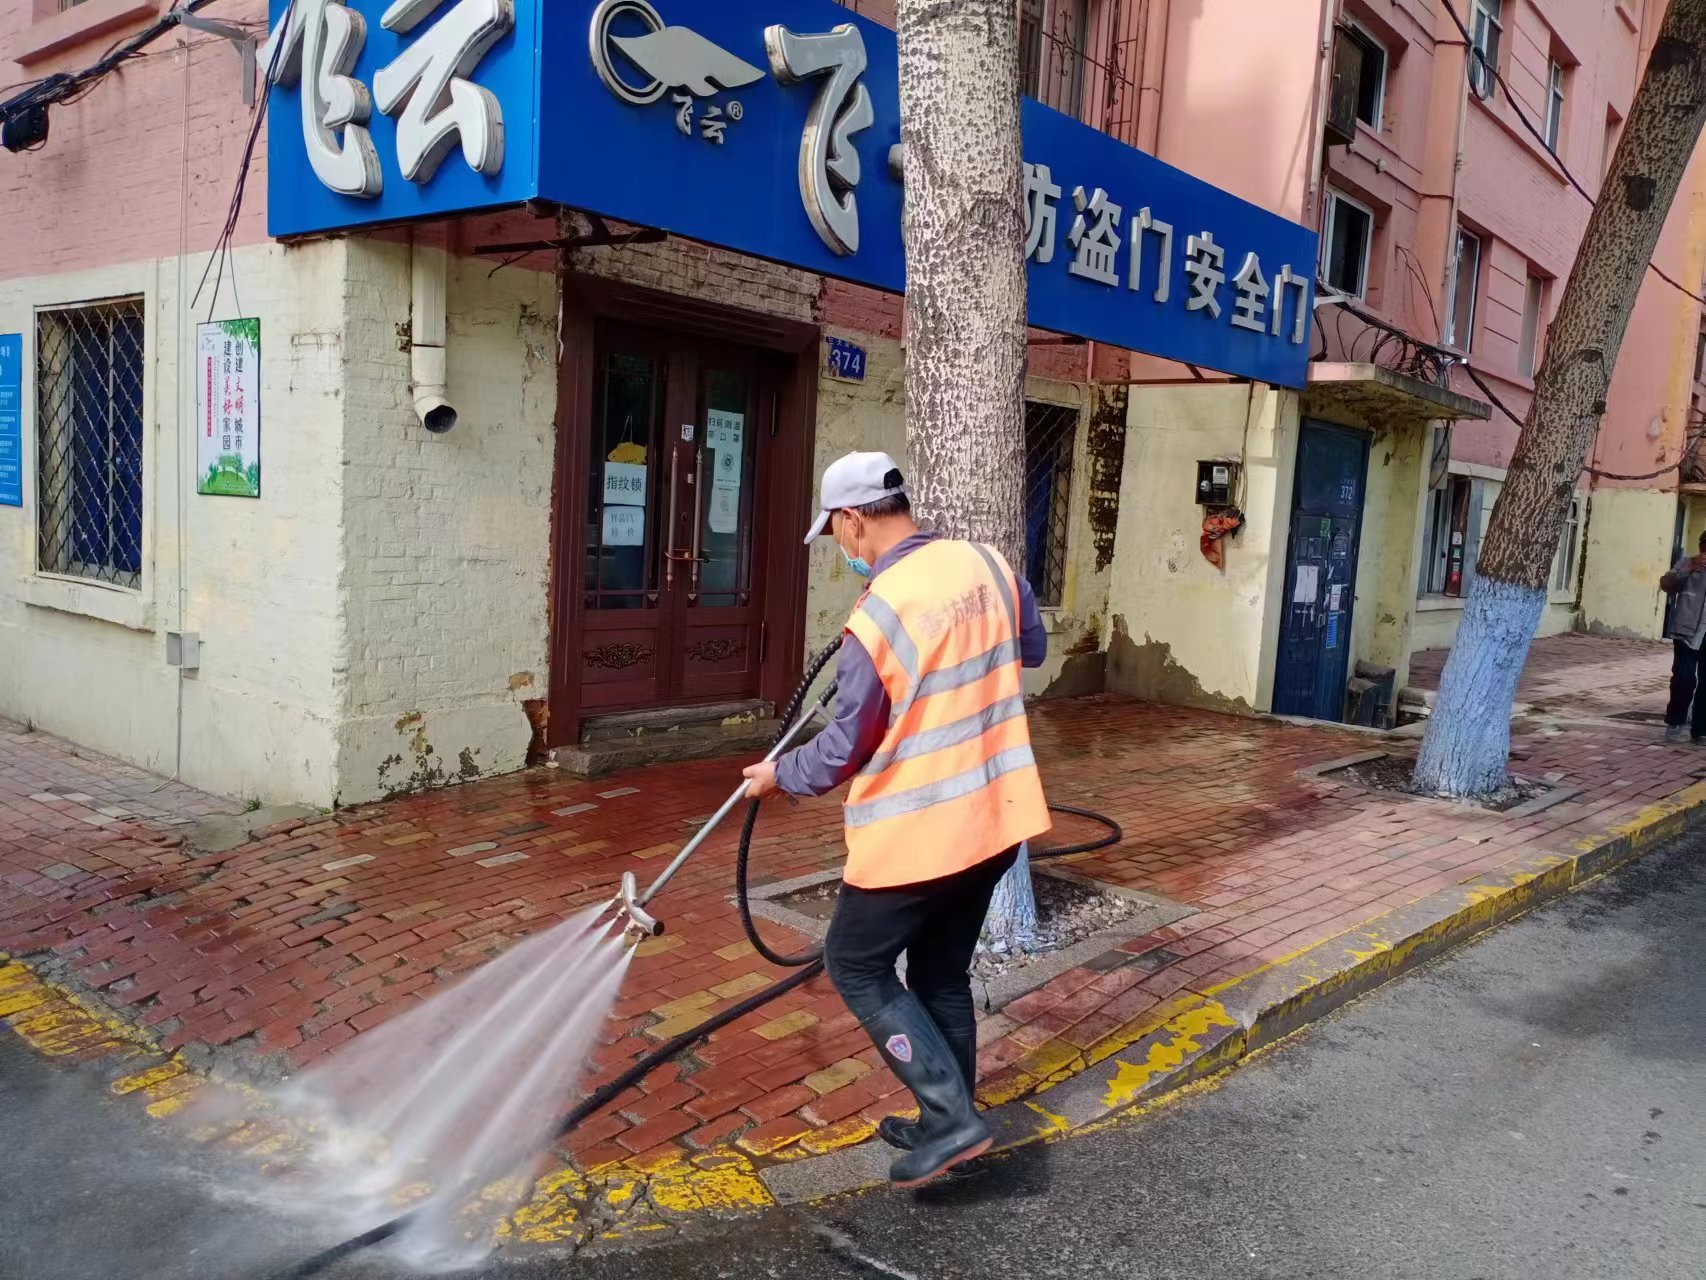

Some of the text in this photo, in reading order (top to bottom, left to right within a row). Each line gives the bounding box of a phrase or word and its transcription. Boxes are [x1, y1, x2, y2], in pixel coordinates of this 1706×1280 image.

[1022, 163, 1309, 344] 防盗门安全门
[831, 348, 861, 374] 374
[222, 340, 233, 451] 建设美好家园
[234, 340, 245, 451] 创建文明城市
[607, 474, 643, 492] 指纹锁
[1340, 485, 1353, 500] 372
